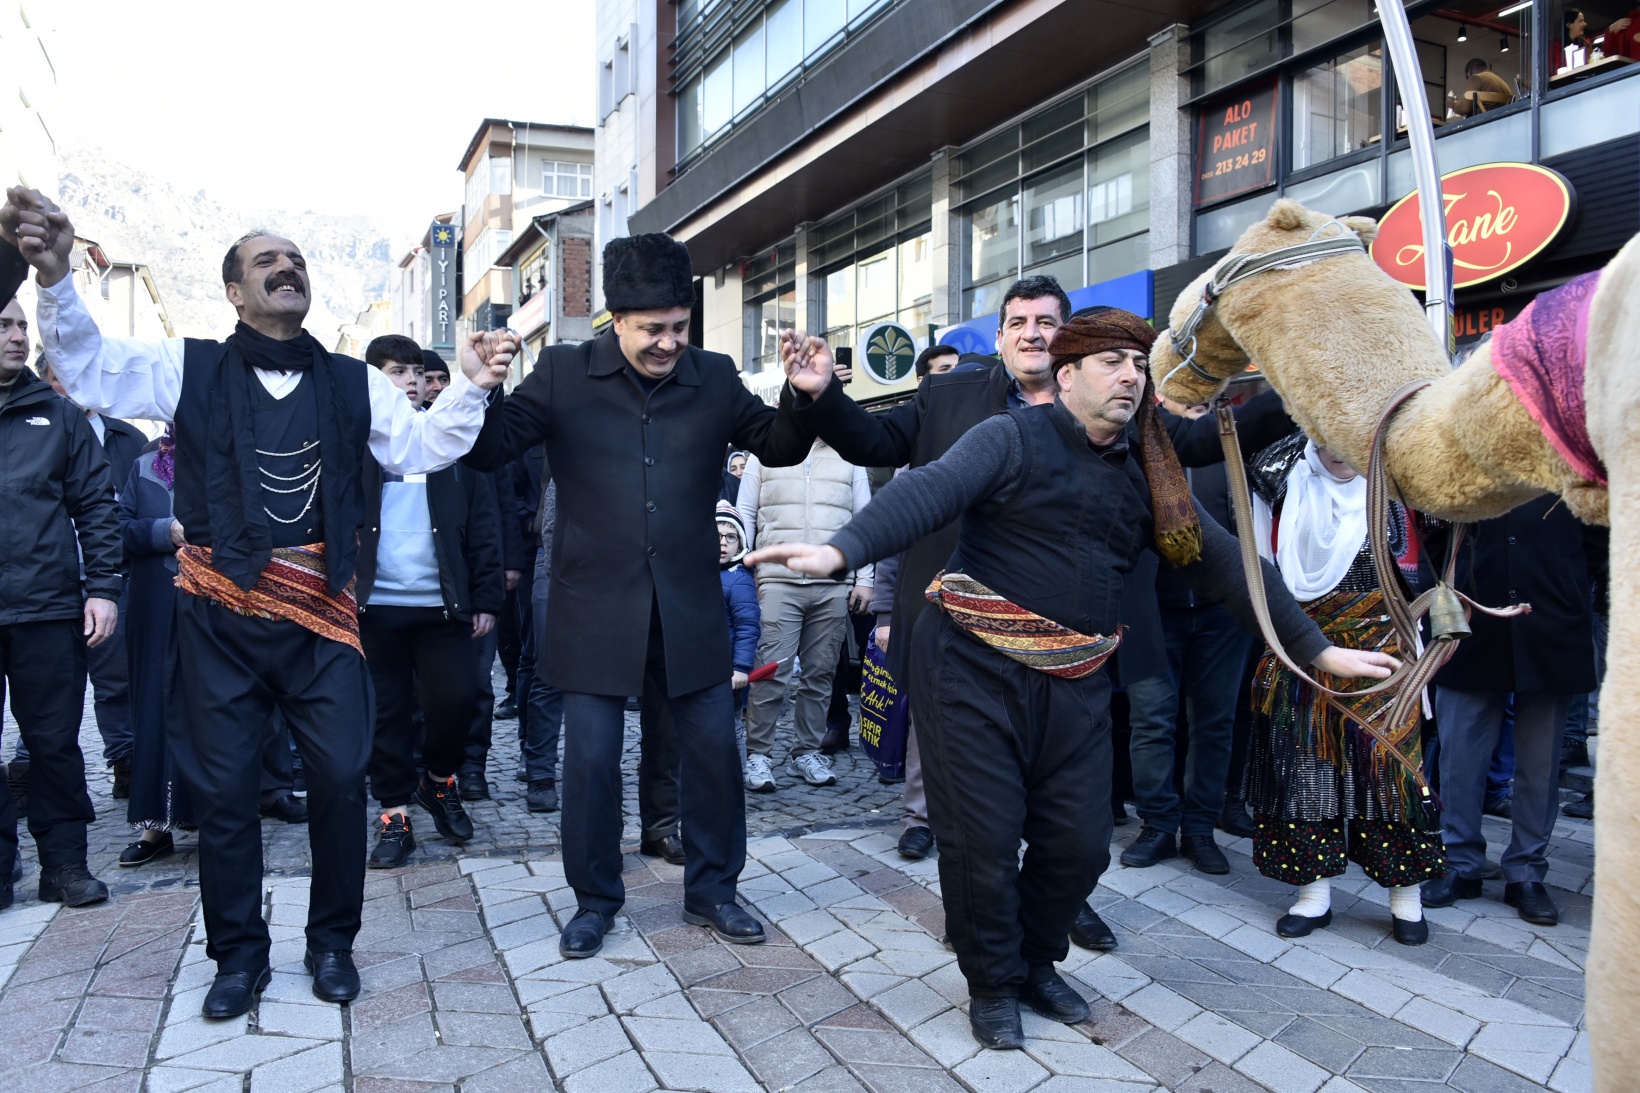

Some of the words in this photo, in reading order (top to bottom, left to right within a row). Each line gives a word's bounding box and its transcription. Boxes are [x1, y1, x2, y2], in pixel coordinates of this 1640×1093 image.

[1224, 100, 1252, 126] ALO
[1213, 122, 1258, 154] PAKET
[1215, 158, 1233, 176] 213
[1234, 155, 1250, 170] 24
[1251, 148, 1267, 164] 29
[1454, 307, 1505, 337] ÜLER
[863, 717, 882, 736] SIFIR
[863, 729, 880, 748] ATIK
